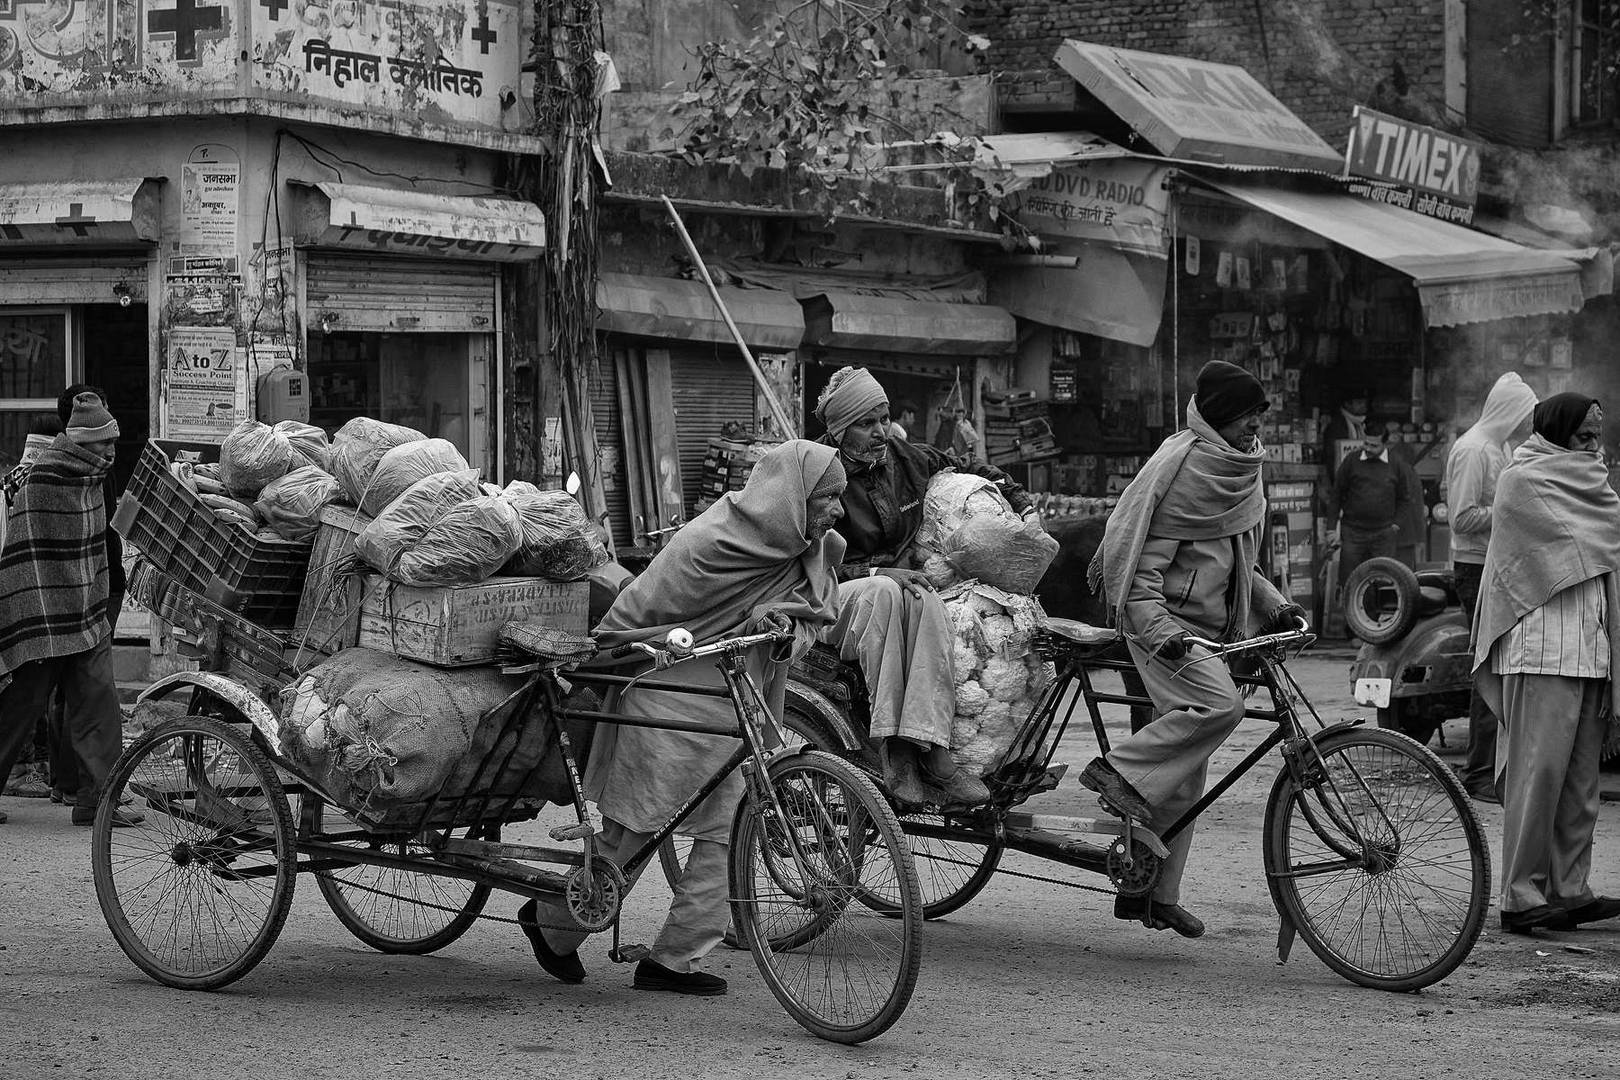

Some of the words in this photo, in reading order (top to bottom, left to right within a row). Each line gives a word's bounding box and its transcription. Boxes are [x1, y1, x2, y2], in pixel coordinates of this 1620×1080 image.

[302, 38, 381, 89] निहाल
[1375, 119, 1468, 195] TIMEX
[202, 174, 236, 184] जनसभा
[1095, 179, 1146, 206] RADIO
[1104, 206, 1117, 227] है
[172, 347, 191, 370] A
[192, 354, 210, 369] to
[210, 348, 233, 371] Z
[173, 370, 207, 379] Success
[210, 371, 232, 379] Point
